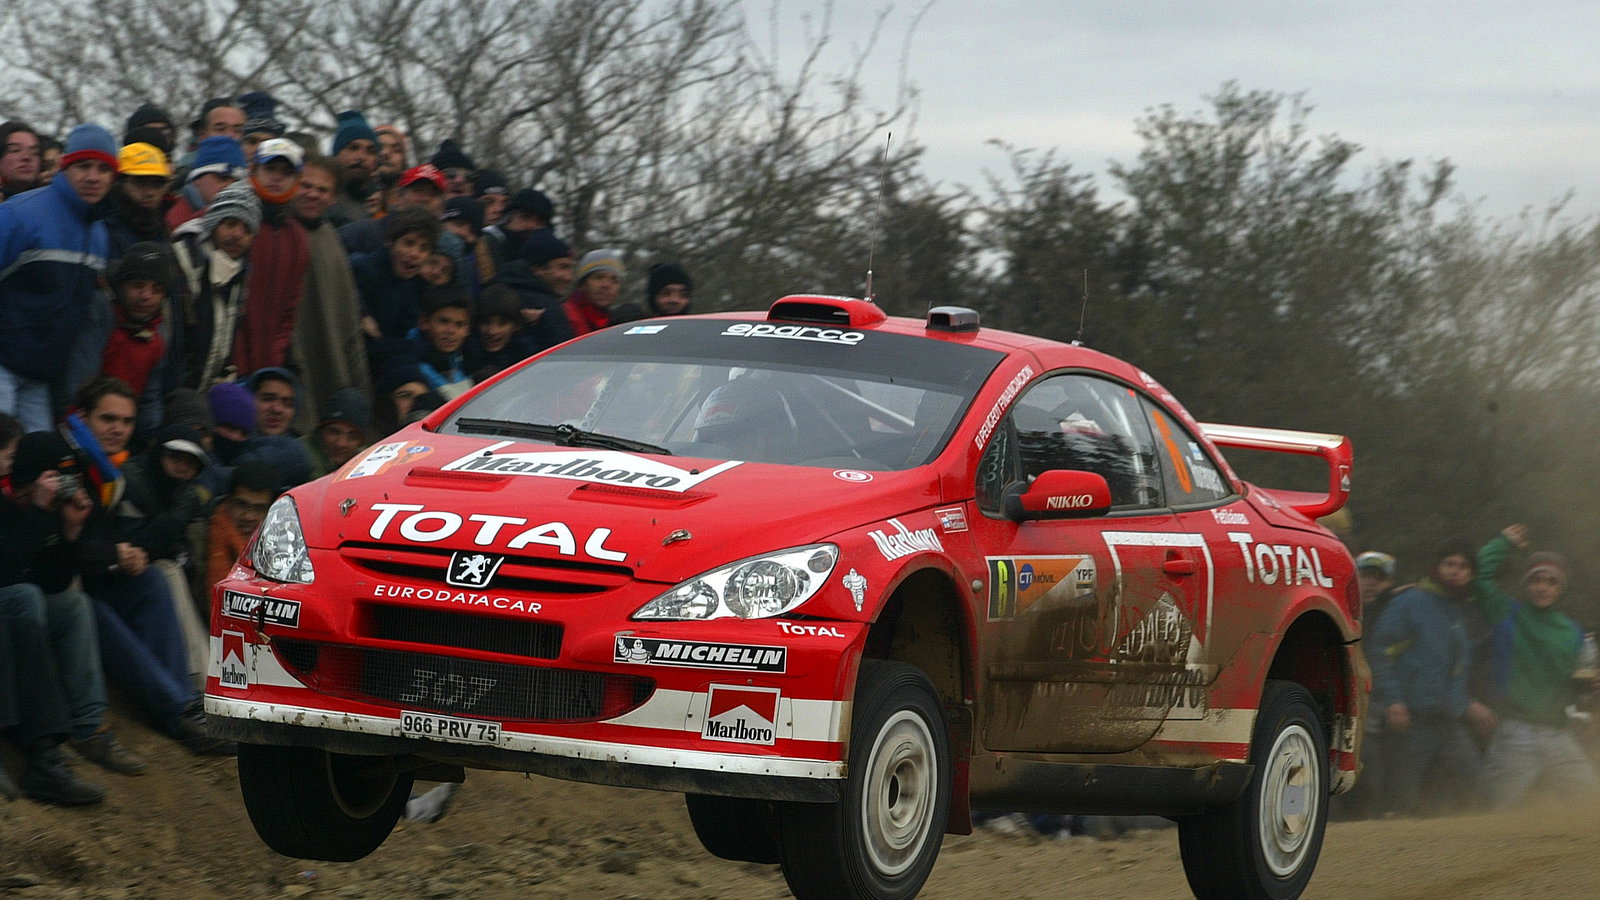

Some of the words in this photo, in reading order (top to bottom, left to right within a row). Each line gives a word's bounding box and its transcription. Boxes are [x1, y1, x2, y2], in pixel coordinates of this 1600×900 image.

[721, 323, 865, 344] sparco
[453, 456, 681, 489] Marlboro
[1046, 494, 1093, 509] NIKKO
[368, 503, 628, 562] TOTAL
[866, 517, 945, 561] Marlboro
[1227, 532, 1334, 588] TOTAL
[1075, 569, 1094, 581] YPF
[231, 595, 297, 619] MICHLIN
[373, 584, 543, 614] EURODATACAR
[776, 621, 846, 638] TOTAL
[655, 643, 783, 665] MICHELIN
[222, 664, 247, 686] Marlboro
[403, 715, 433, 733] 966
[438, 719, 472, 738] PRV
[477, 725, 498, 742] 75
[706, 718, 773, 742] Marlboro
